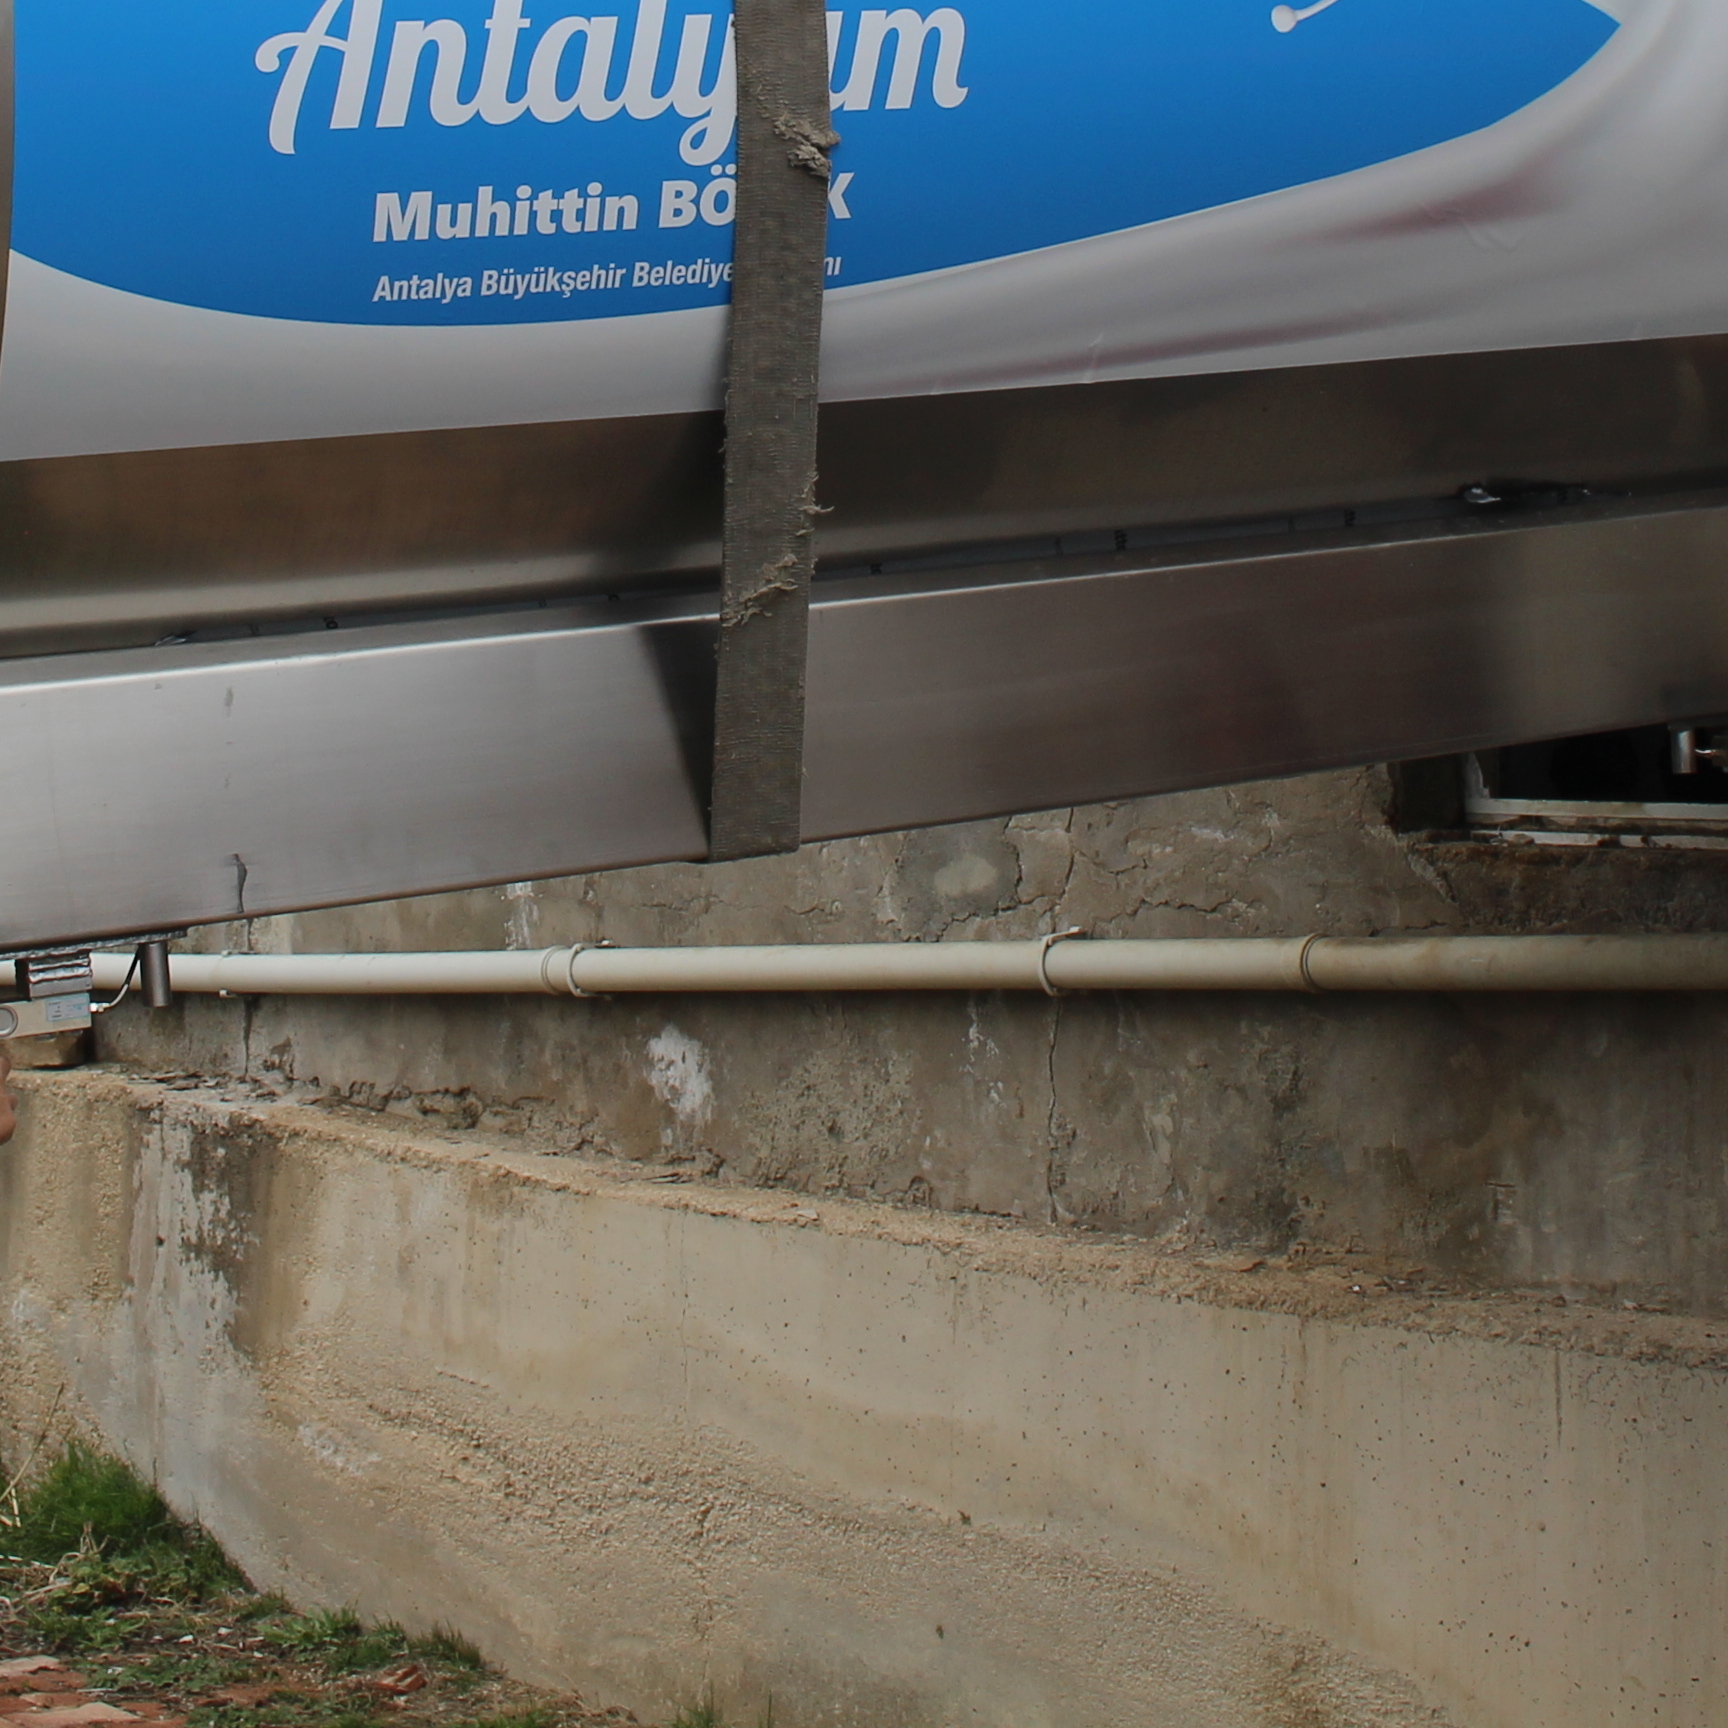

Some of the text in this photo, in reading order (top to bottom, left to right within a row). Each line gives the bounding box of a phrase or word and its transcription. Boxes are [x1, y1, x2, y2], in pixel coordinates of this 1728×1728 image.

[372, 163, 855, 243] Muhittin BÖK
[372, 273, 473, 304] Antalya
[480, 263, 627, 300] Büyükşehir
